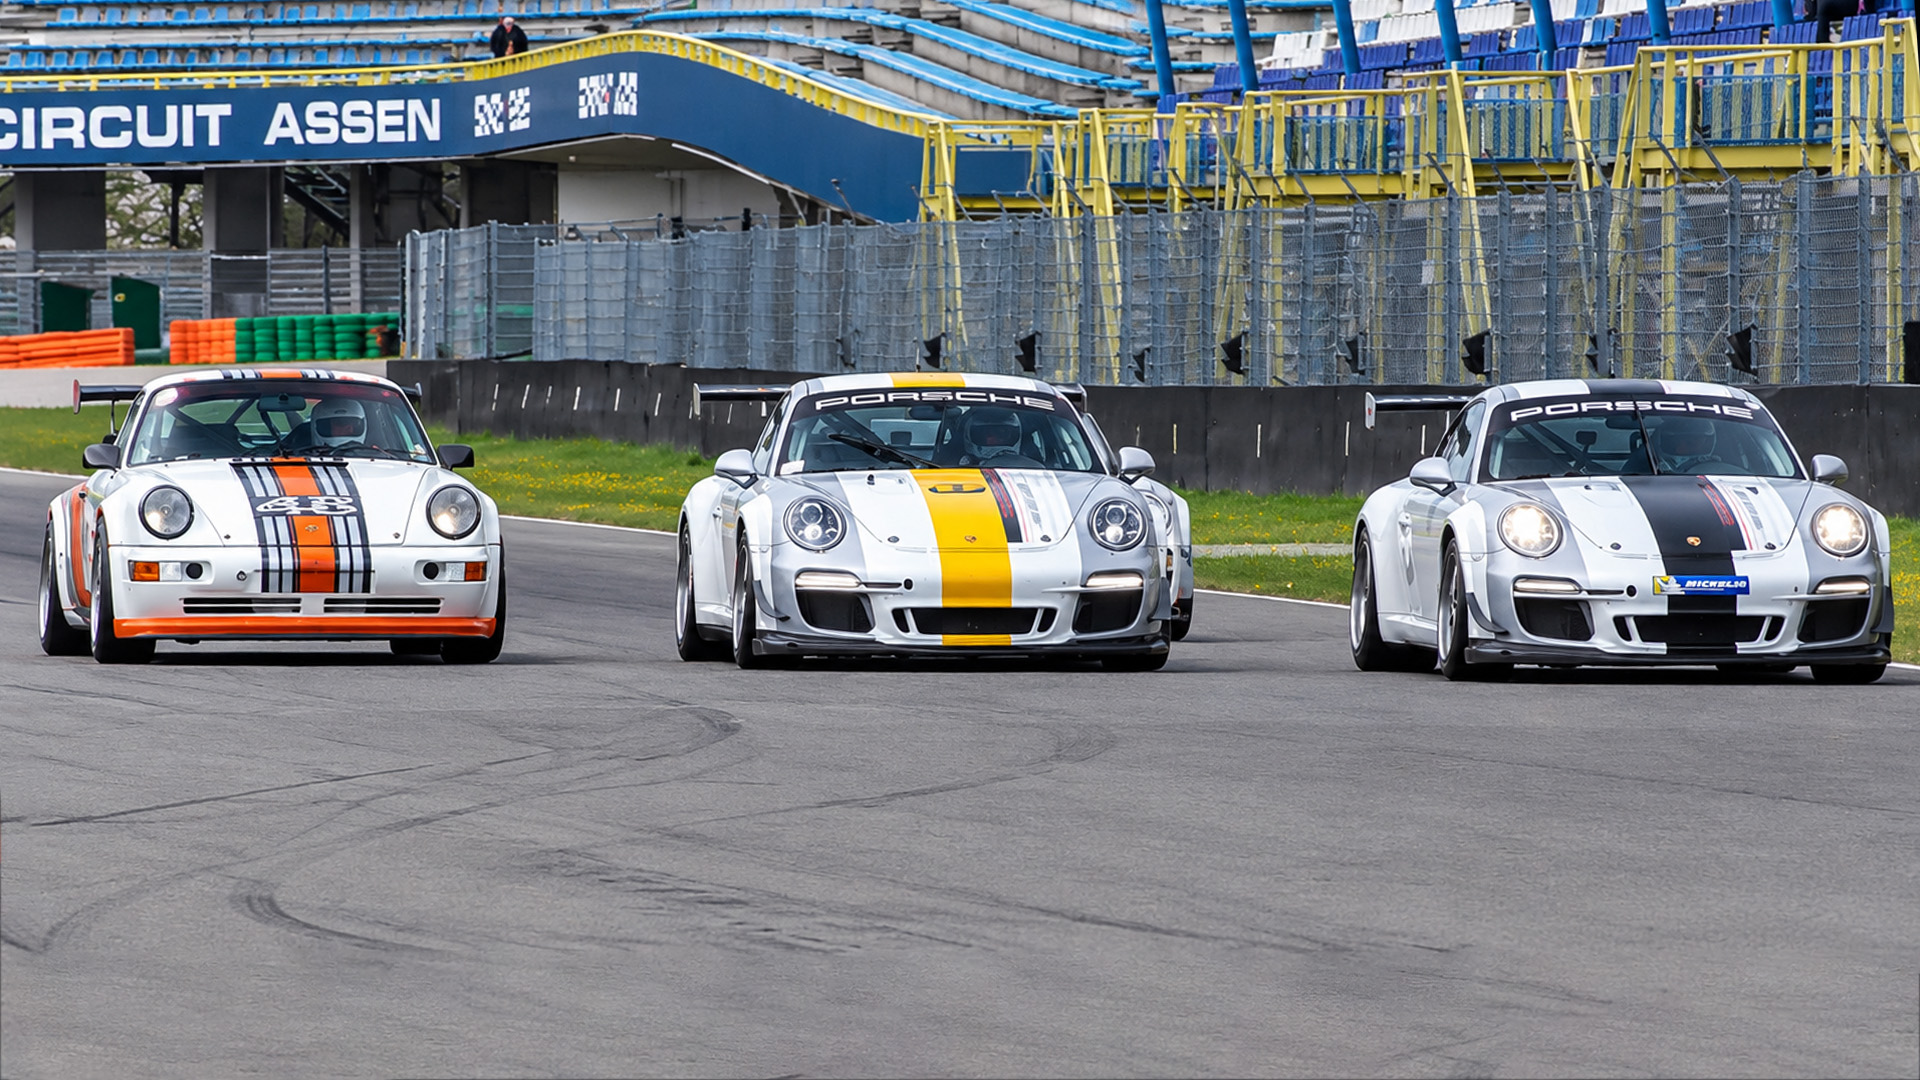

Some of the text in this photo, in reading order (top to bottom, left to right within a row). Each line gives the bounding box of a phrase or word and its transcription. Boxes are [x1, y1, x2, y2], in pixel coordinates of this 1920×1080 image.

[263, 98, 441, 146] ASSEN
[815, 391, 1055, 411] PORSCHE
[1510, 401, 1753, 421] PORSCHE
